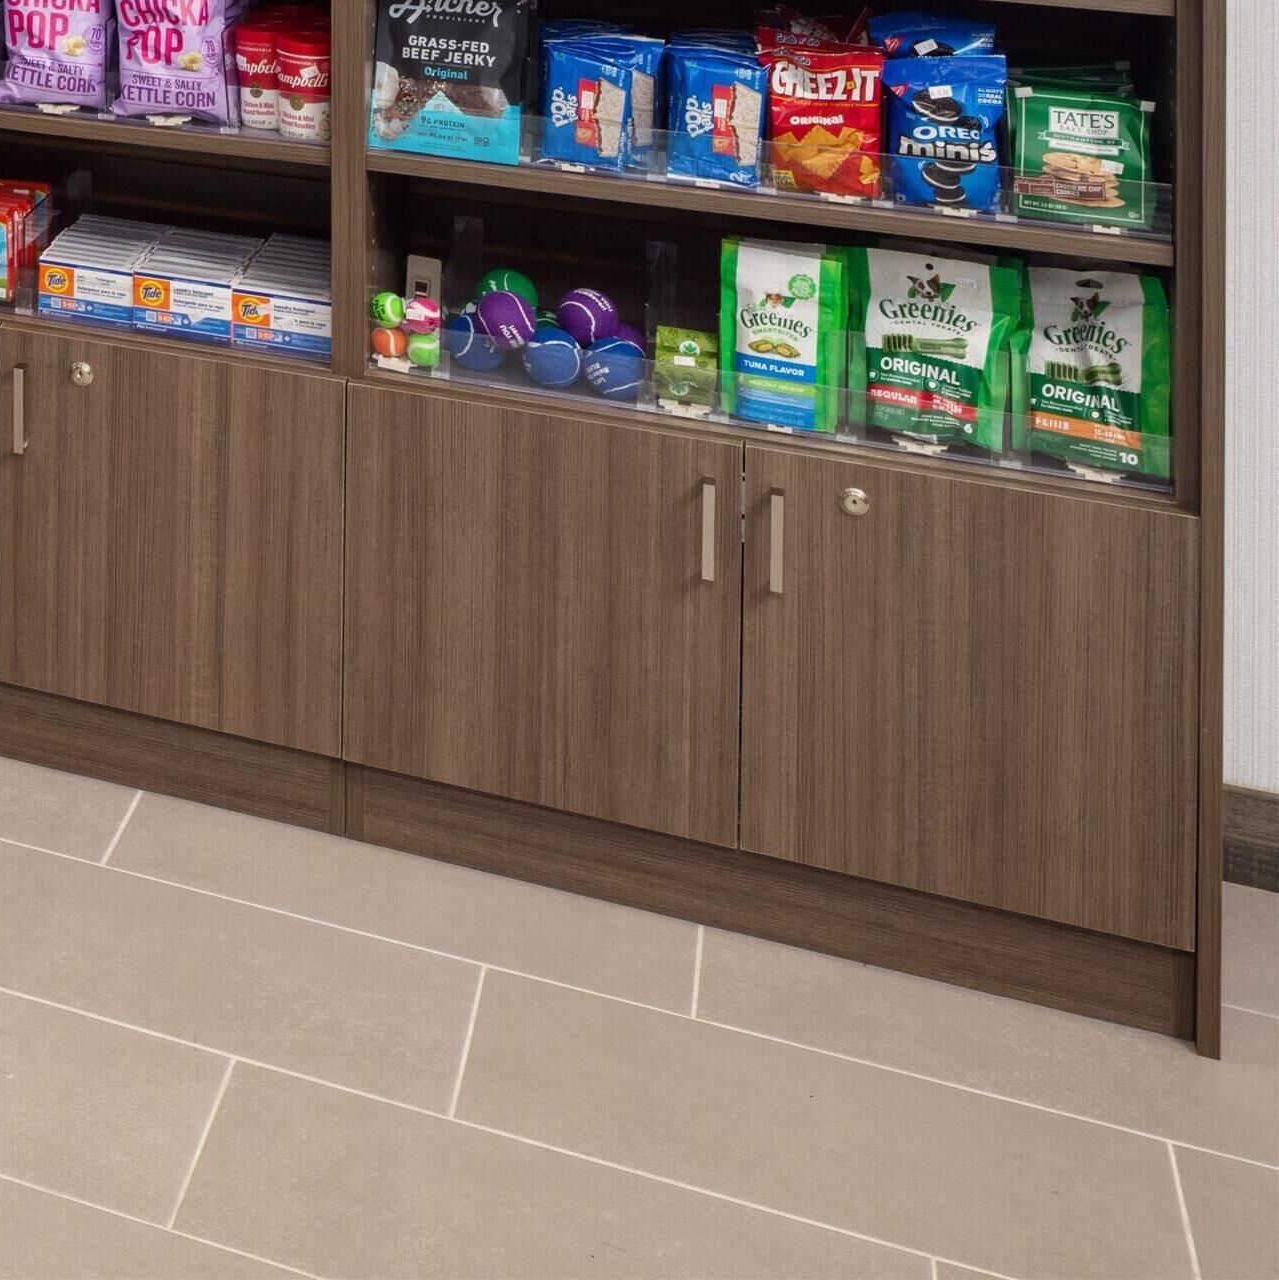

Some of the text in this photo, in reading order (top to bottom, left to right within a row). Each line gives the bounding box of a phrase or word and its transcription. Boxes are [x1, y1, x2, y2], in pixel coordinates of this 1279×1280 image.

[8, 8, 70, 51] POP
[126, 25, 185, 66] POP
[408, 34, 490, 54] GRASS-FED
[402, 47, 496, 68] BEEF JERKY
[57, 63, 84, 76] SALTY
[423, 66, 468, 81] Original
[132, 73, 203, 92] SWEET SALTY
[176, 90, 216, 109] CORN
[433, 117, 466, 129] PROTEIN
[1053, 111, 1115, 129] TATE'S
[912, 124, 980, 141] OREO
[1086, 128, 1109, 136] SHOP
[898, 134, 997, 163] minis
[47, 274, 66, 287] Tide
[142, 286, 162, 300] Tide
[740, 307, 813, 339] Greenies
[879, 298, 978, 333] Greenies
[1043, 322, 1129, 356] Greenies
[744, 360, 805, 377] TUNA FLAVOR
[880, 356, 961, 386] ORIGINAL
[1042, 383, 1119, 412] ORIGINAL
[964, 422, 974, 434] 6
[1119, 452, 1139, 466] 10
